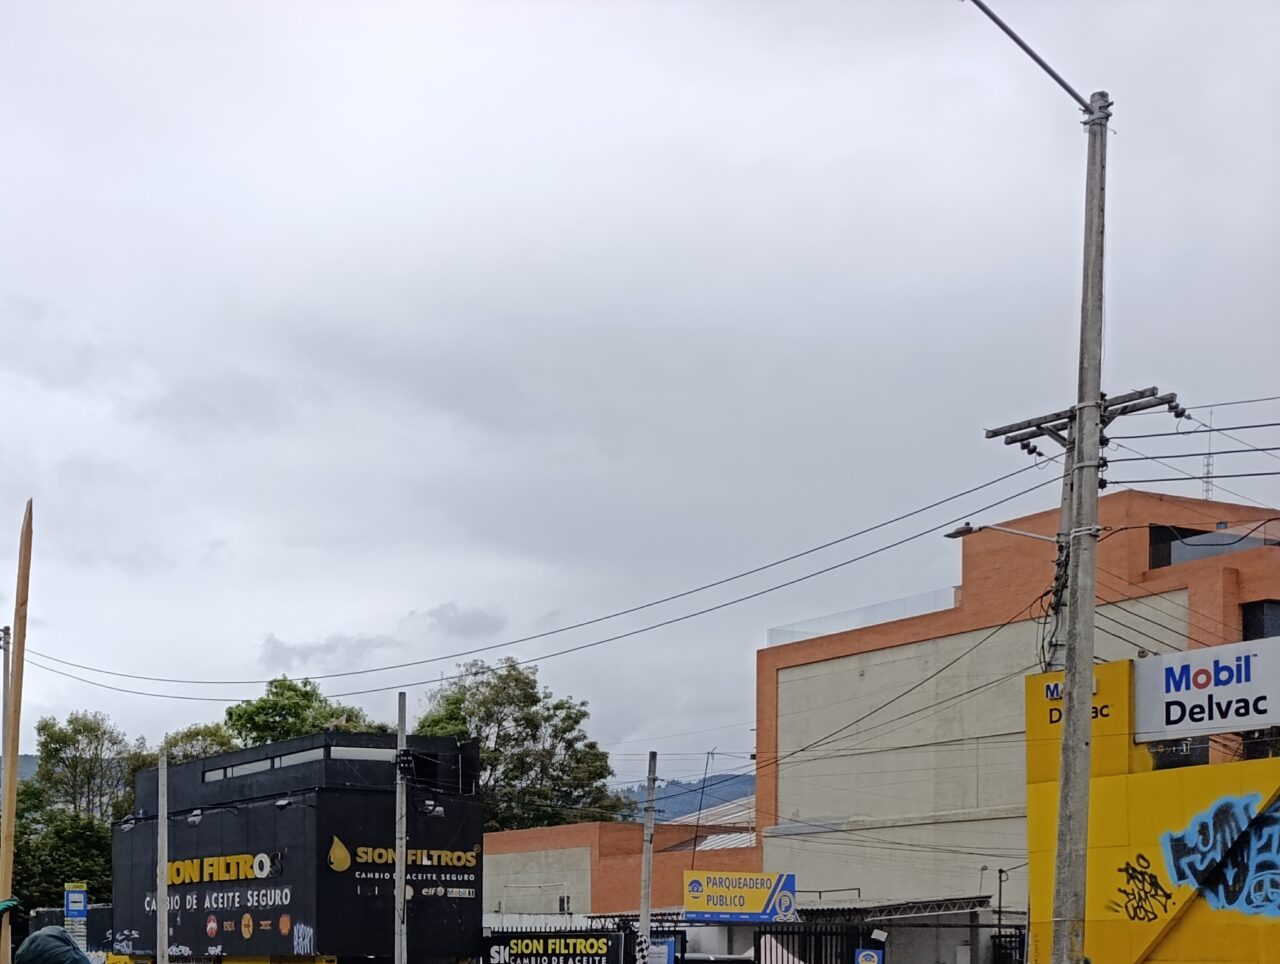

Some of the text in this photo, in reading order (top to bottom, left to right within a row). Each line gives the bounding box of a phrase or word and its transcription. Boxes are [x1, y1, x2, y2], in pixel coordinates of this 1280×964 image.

[1164, 654, 1251, 693] Mobil
[1049, 704, 1110, 724] Dac
[1164, 693, 1268, 726] Delvac
[407, 849, 477, 867] FILTROS
[167, 859, 200, 885] ION
[355, 871, 390, 879] CAMBIO
[706, 876, 772, 890] PARQUEADERO
[144, 888, 291, 912] CABIO DE ACEITE SEGURO
[706, 891, 745, 906] PÚBLICO
[509, 938, 608, 954] SION FILTROS
[509, 956, 607, 964] CAMBIO DE ACEITE
